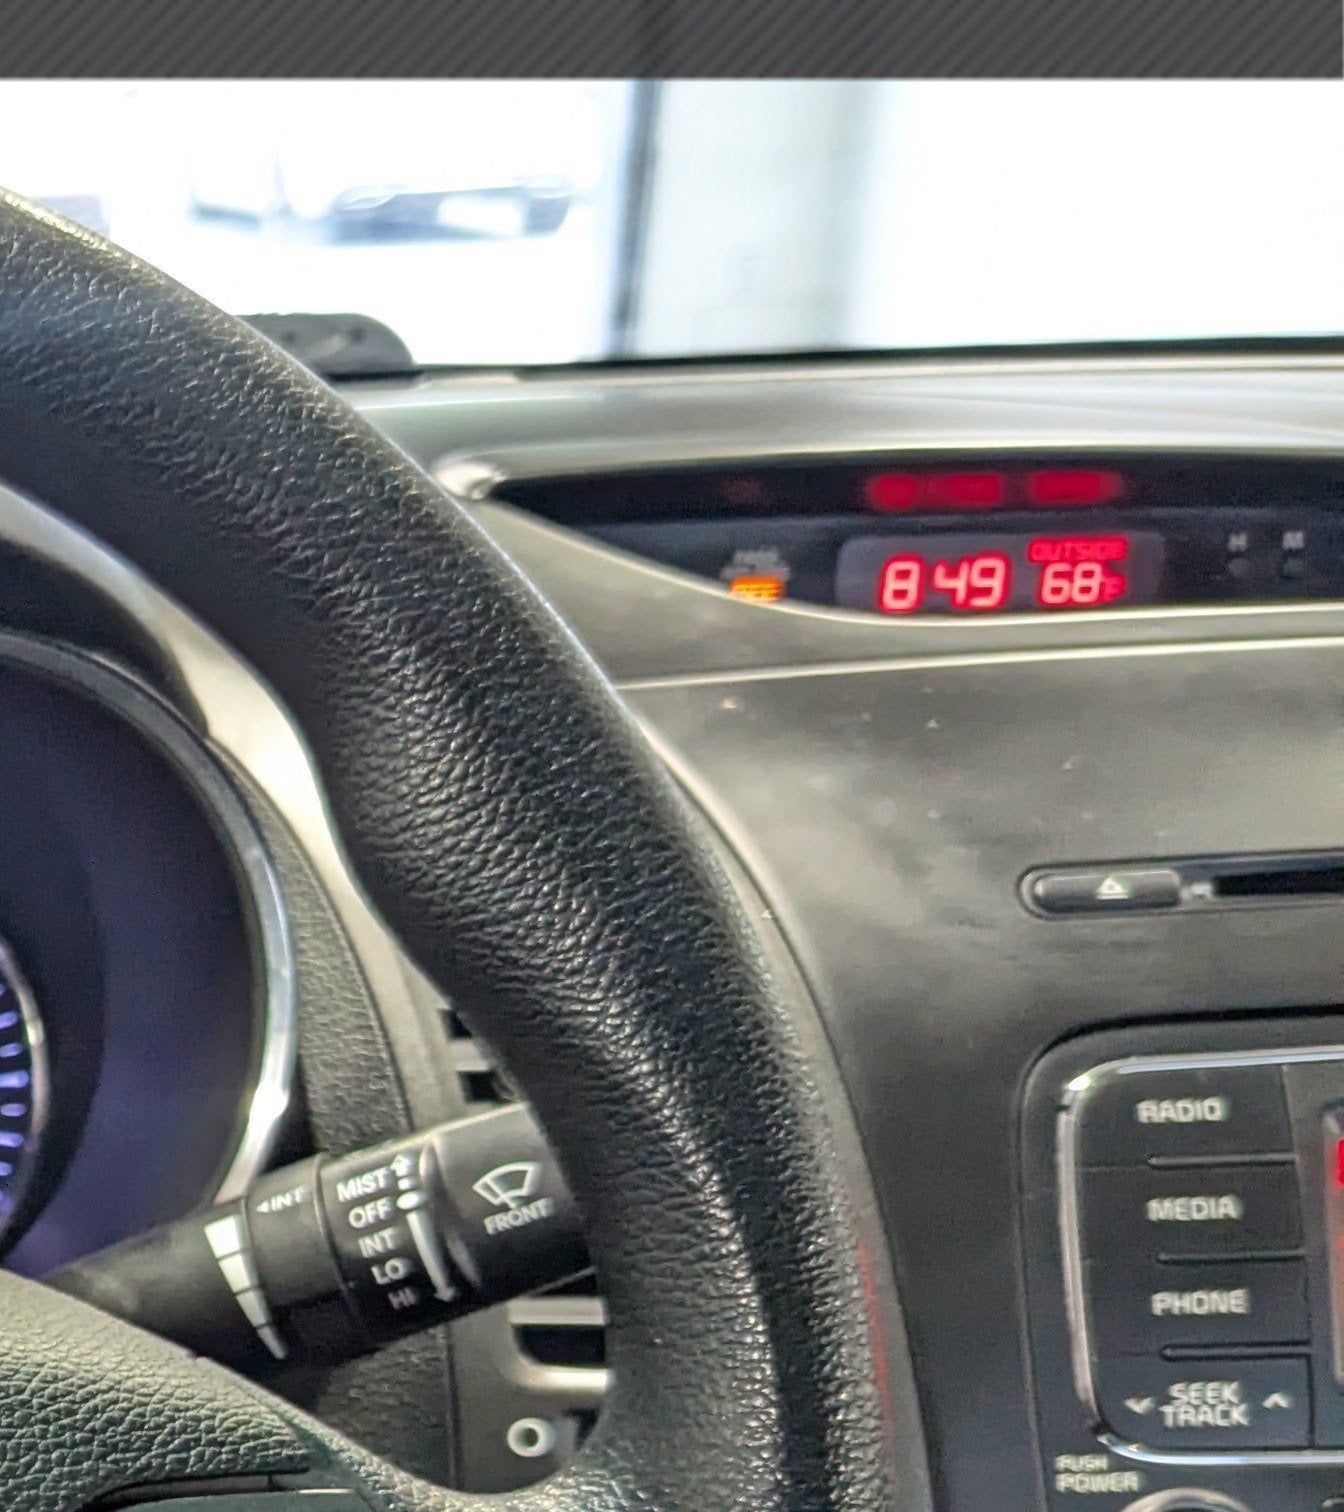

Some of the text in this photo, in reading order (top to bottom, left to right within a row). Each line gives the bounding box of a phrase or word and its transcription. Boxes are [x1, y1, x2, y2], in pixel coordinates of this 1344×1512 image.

[1136, 1098, 1226, 1124] RADIO
[336, 1170, 390, 1202] MIST
[268, 1186, 310, 1213] INT
[1145, 1197, 1241, 1222] MEDIA
[348, 1203, 396, 1230] OFF
[483, 1198, 555, 1237] FRONT
[358, 1232, 400, 1258] INT
[370, 1257, 409, 1286] LO
[389, 1287, 418, 1310] HI
[1151, 1290, 1249, 1316] PHONE
[1168, 1381, 1241, 1405] SEEK
[1159, 1402, 1250, 1428] TRACK
[1055, 1454, 1109, 1474] PUSH
[1055, 1472, 1141, 1494] POWER
